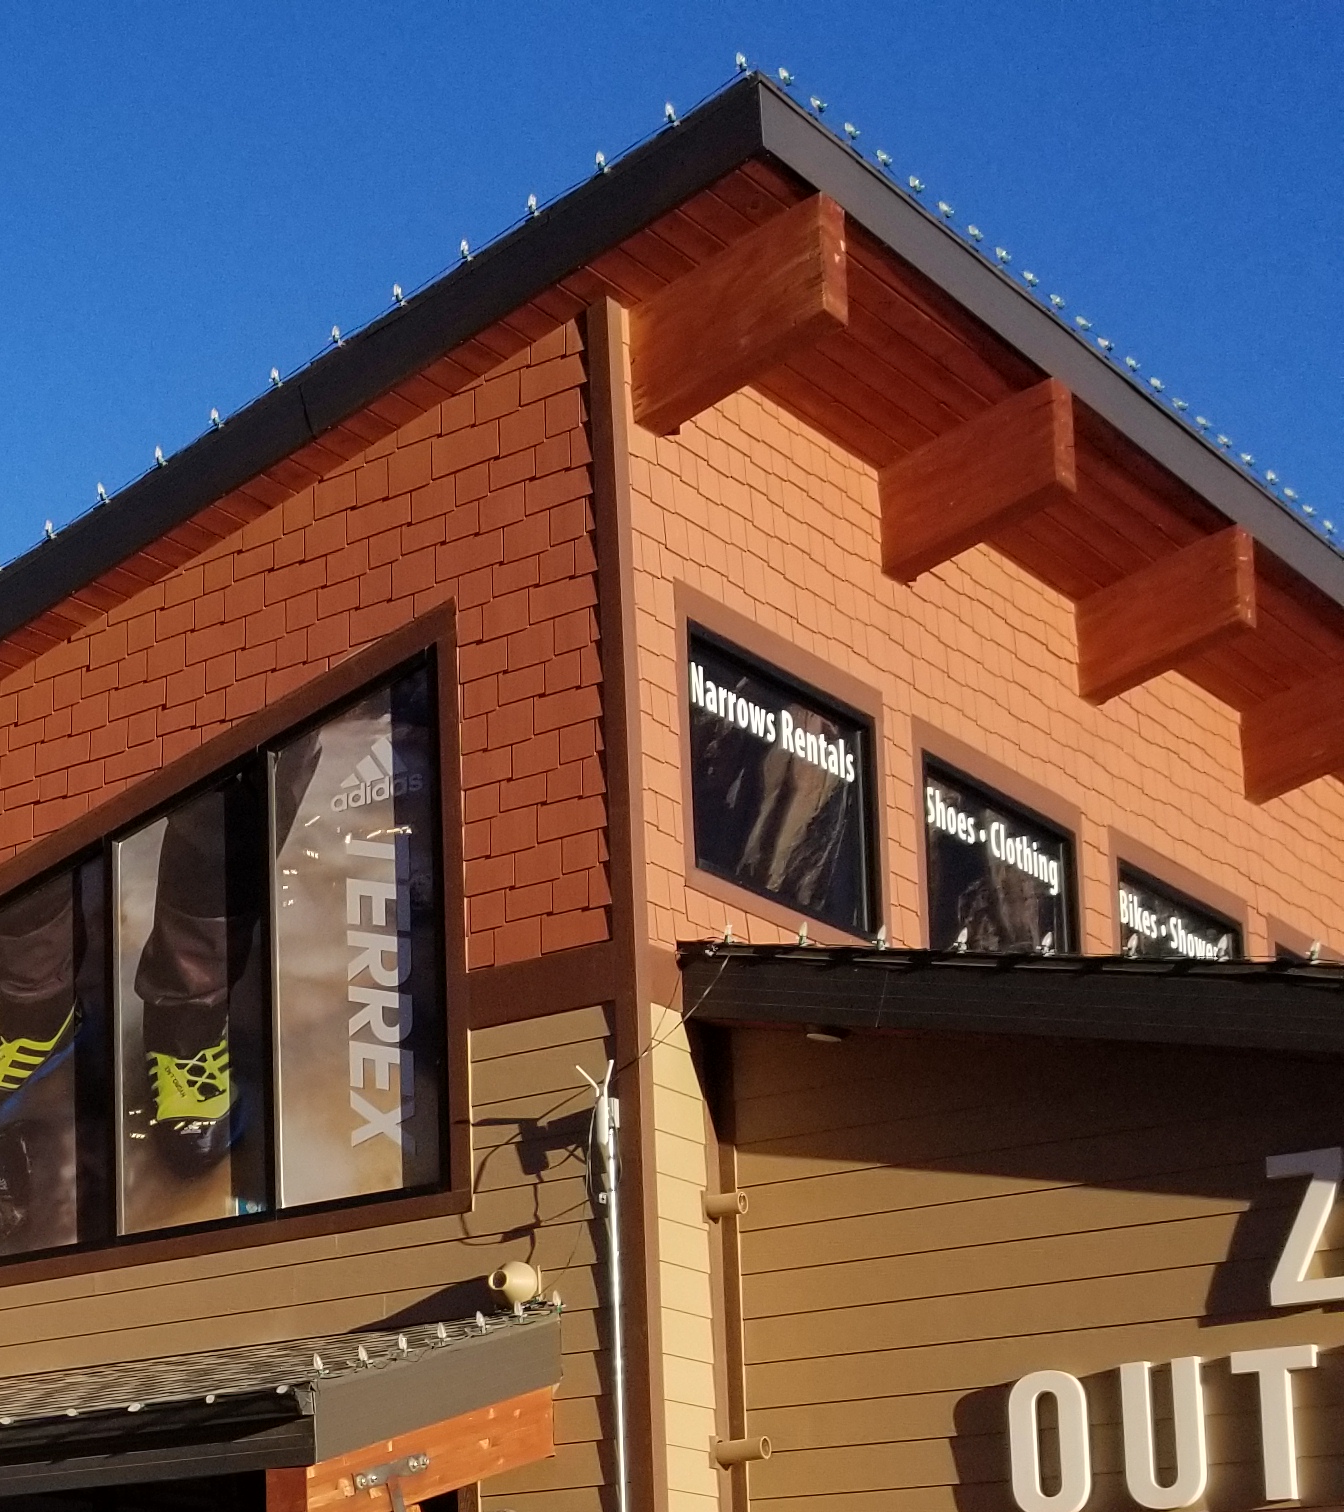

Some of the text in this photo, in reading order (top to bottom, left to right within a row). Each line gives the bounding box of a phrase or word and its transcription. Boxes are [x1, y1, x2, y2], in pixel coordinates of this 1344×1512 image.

[690, 661, 855, 783] Narrows Rentals
[331, 773, 423, 812] adidas
[927, 786, 1059, 895] Shoes Clothing
[1119, 889, 1219, 960] Bikes Shower
[345, 833, 416, 1155] TERREX
